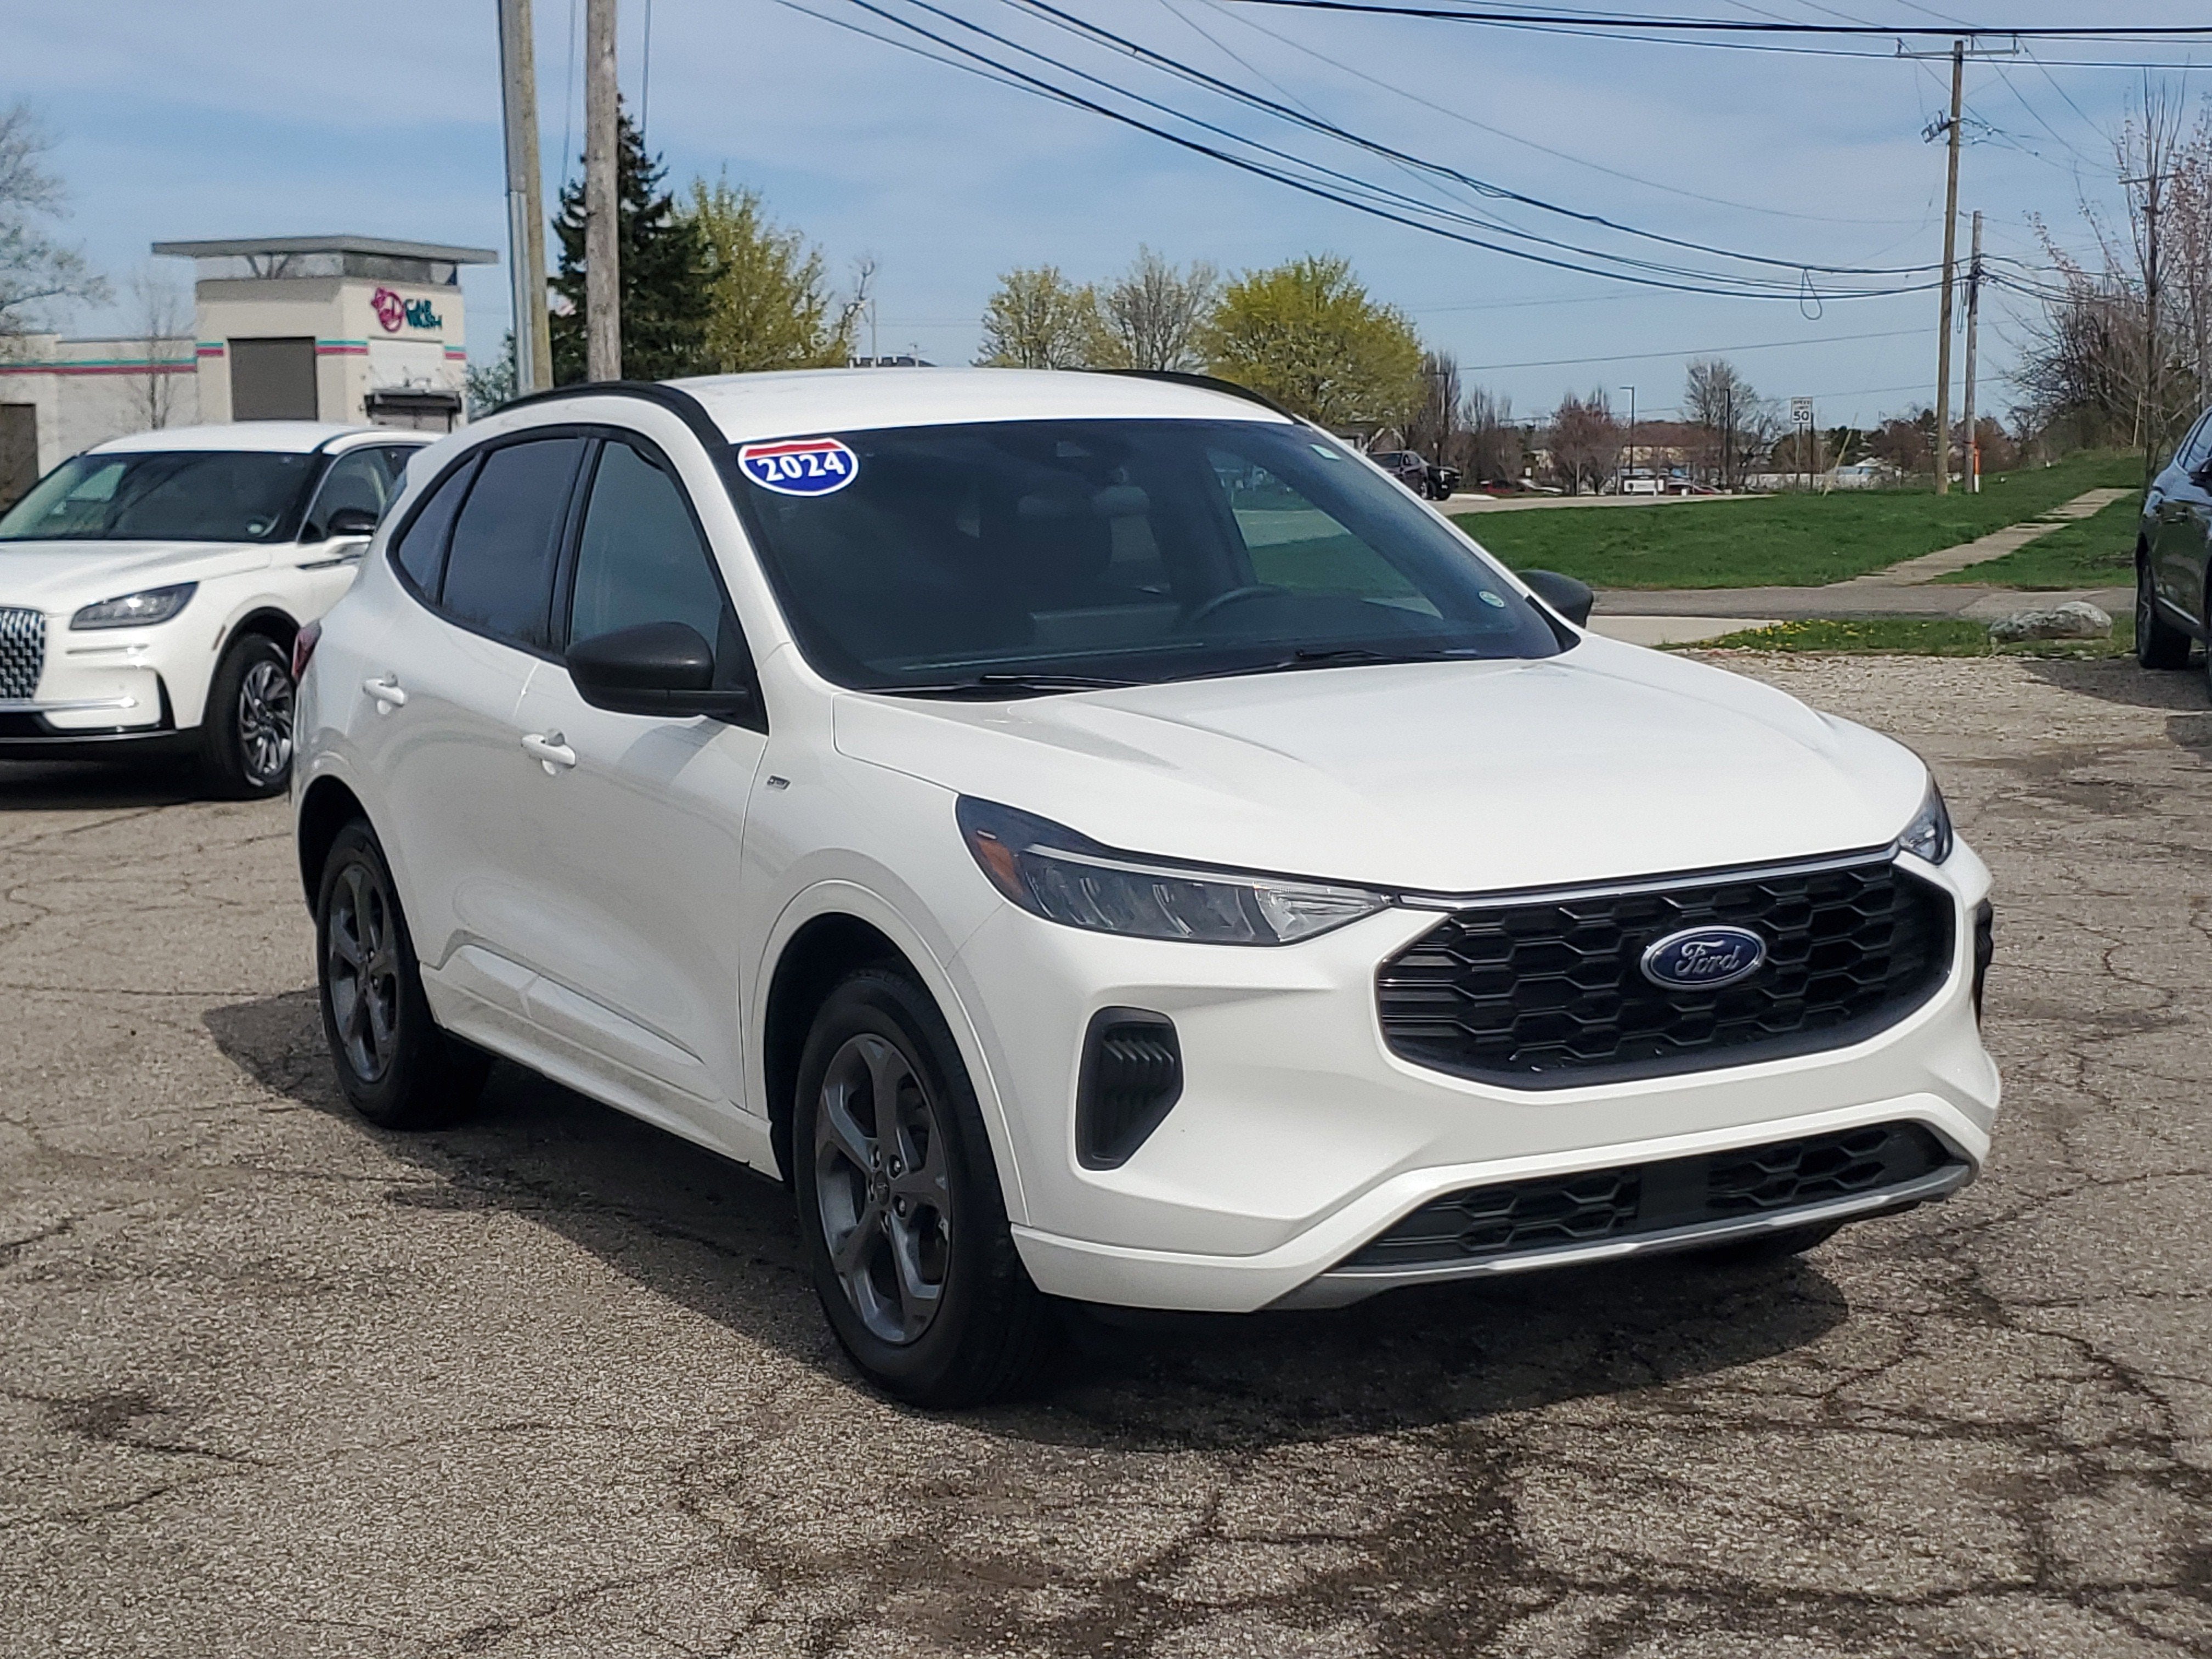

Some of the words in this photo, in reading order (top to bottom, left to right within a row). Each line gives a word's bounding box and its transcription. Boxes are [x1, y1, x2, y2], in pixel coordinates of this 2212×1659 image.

[1793, 411, 1809, 421] 50
[757, 452, 846, 481] 2024
[1675, 940, 1741, 976] Ford
